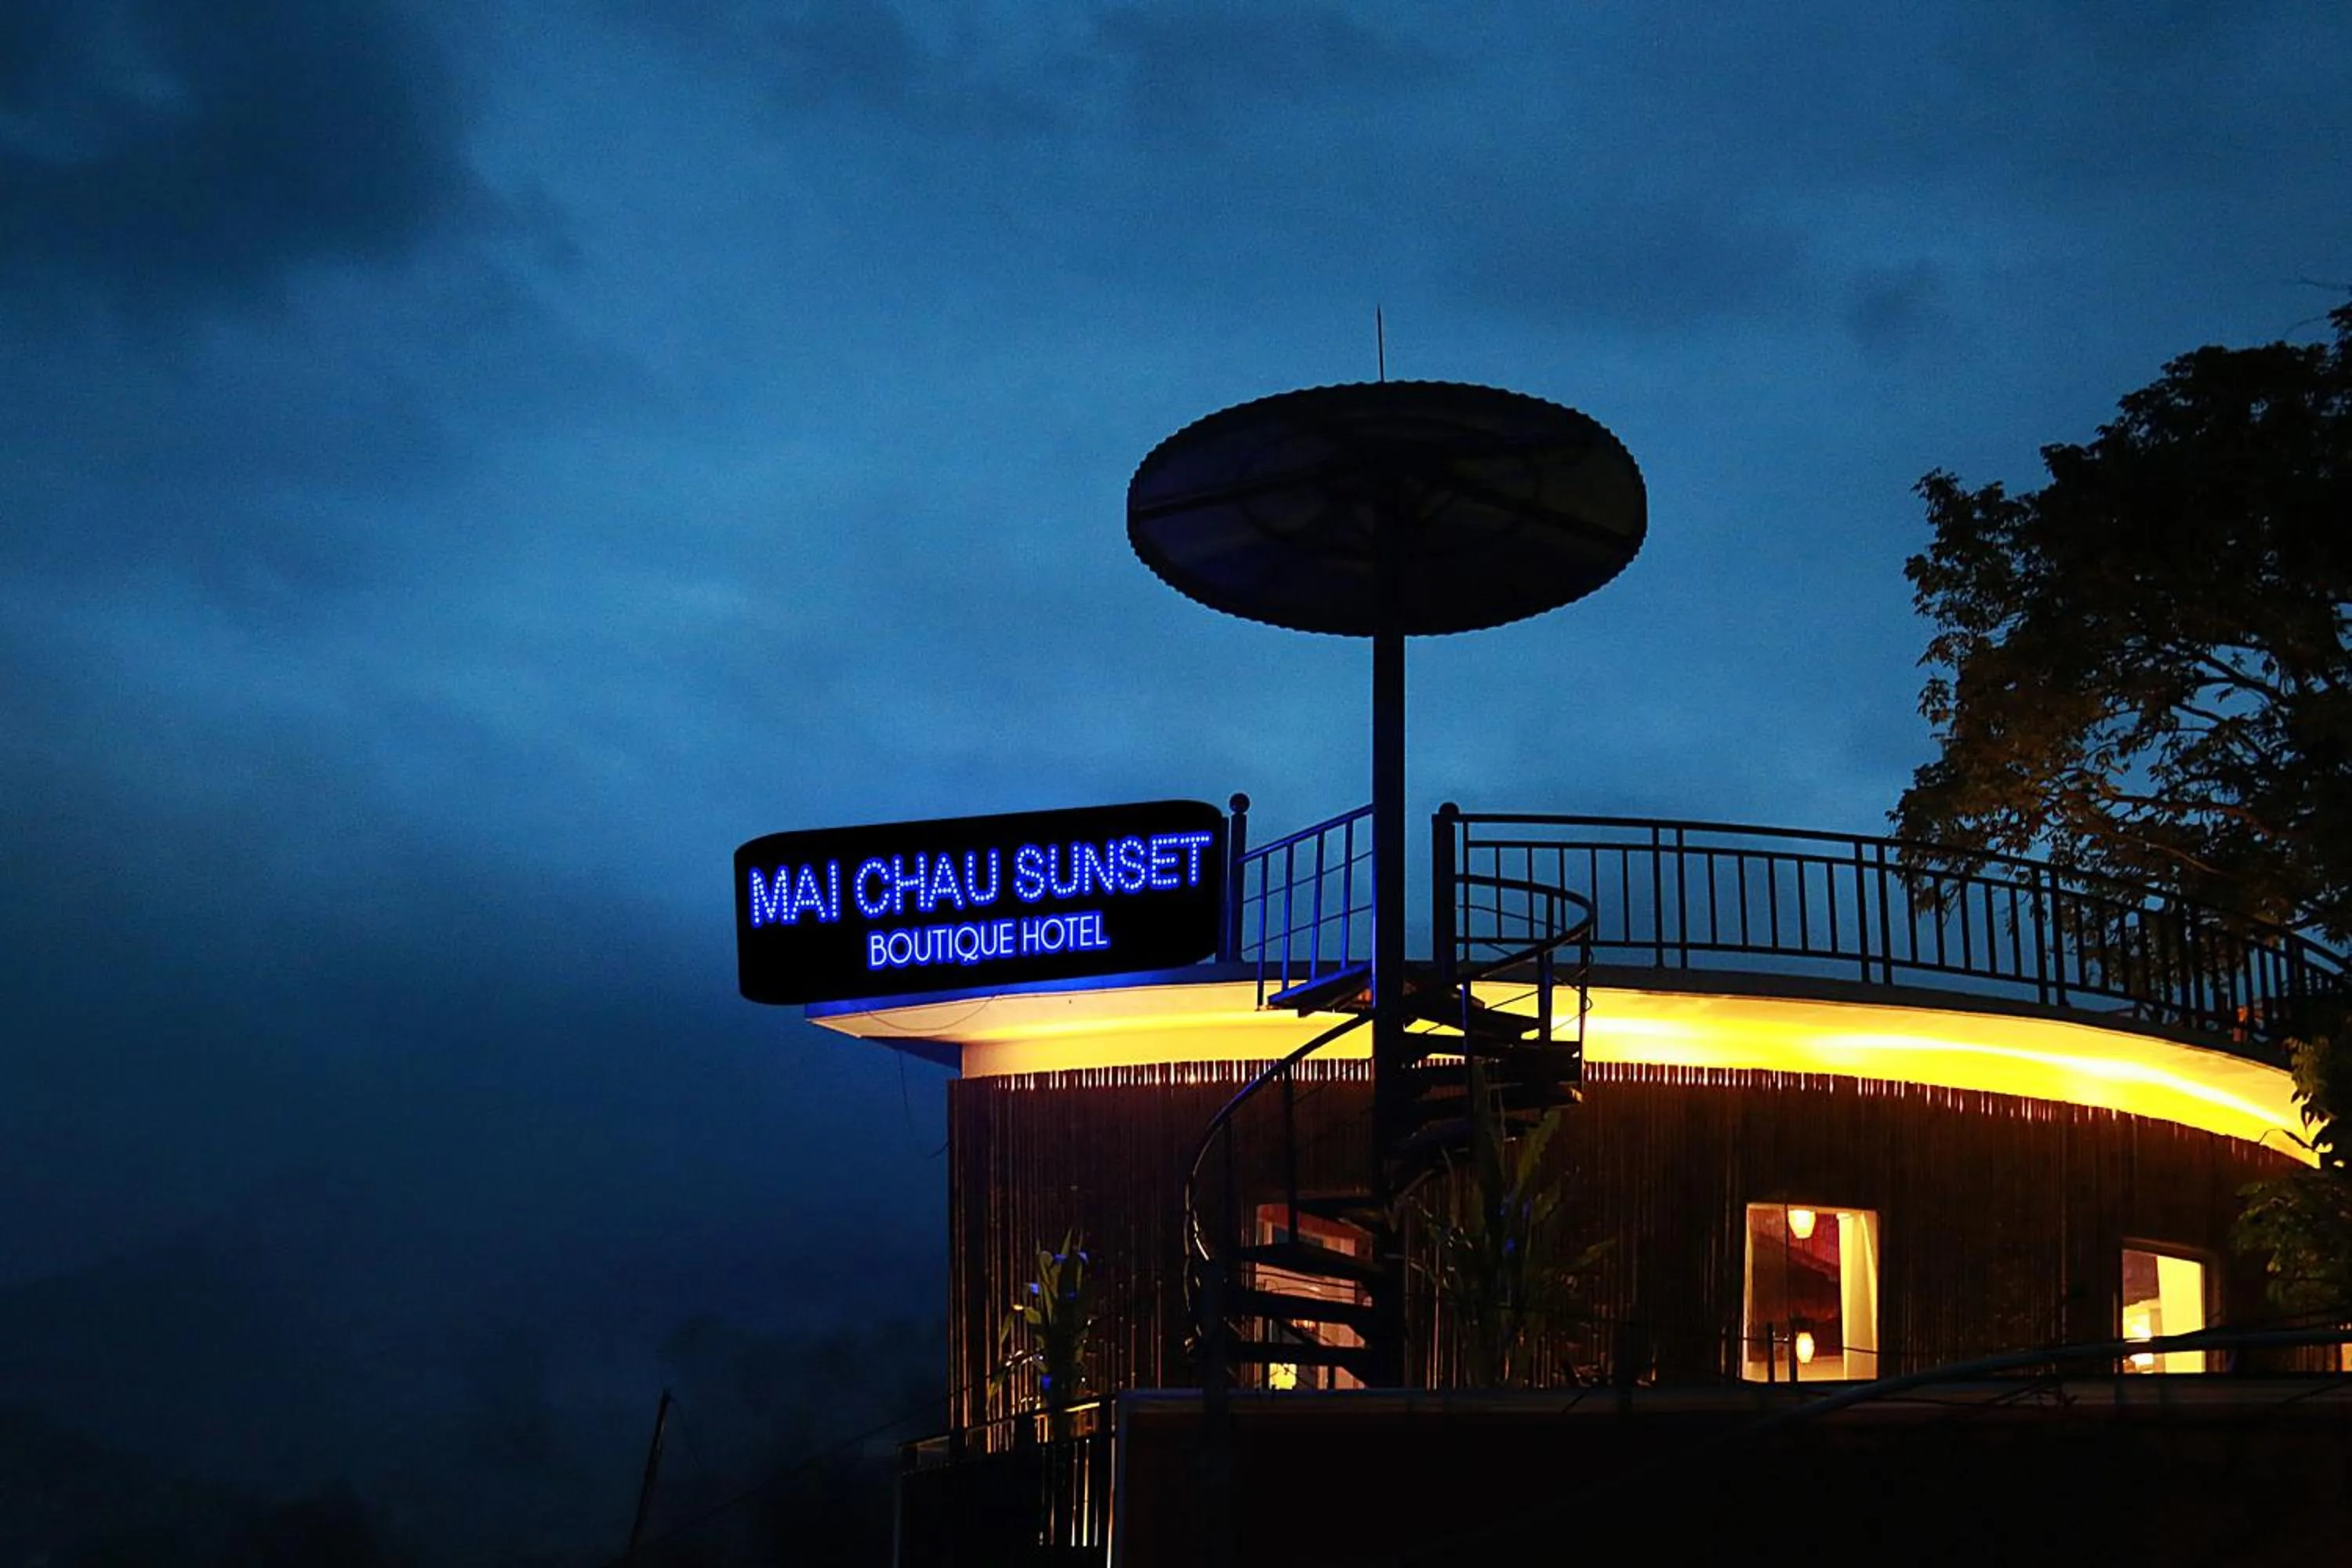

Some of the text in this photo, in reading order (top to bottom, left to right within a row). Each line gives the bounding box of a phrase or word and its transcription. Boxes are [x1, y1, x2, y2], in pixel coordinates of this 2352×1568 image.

[750, 833, 1211, 926] MAI CHAU SUNSET
[868, 913, 1109, 968] BOUTIQUE HOTEL
